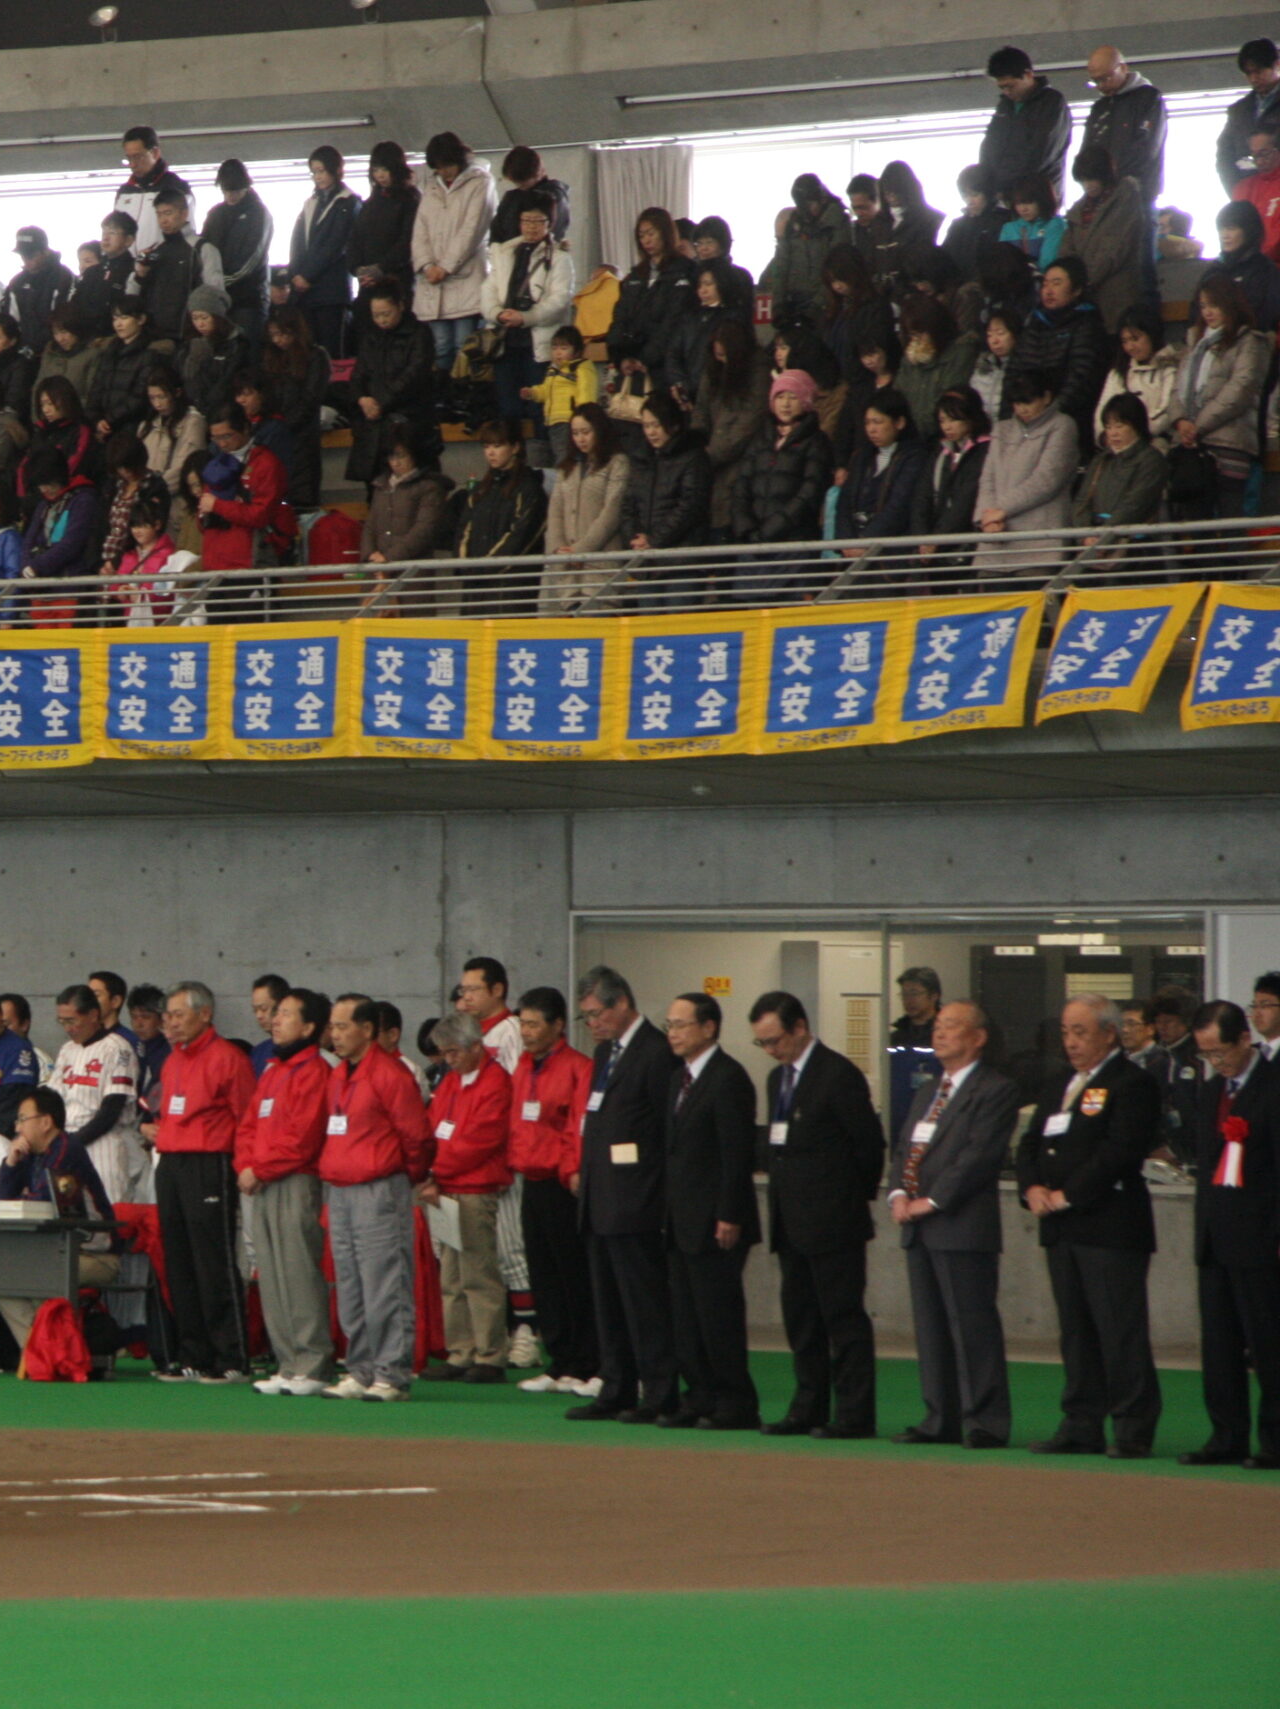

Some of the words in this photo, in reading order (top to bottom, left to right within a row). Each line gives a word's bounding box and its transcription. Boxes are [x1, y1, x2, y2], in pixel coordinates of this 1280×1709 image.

[783, 631, 871, 675] 交通
[923, 616, 1016, 664] 交通
[119, 651, 196, 689] 交通
[245, 646, 324, 686] 交通
[376, 646, 454, 687] 交通
[508, 647, 590, 687] 交通
[643, 641, 728, 684] 交通
[1047, 646, 1133, 685] 安全
[118, 695, 197, 733] 安全
[244, 691, 324, 731] 安全
[373, 691, 455, 731] 安全
[506, 693, 590, 733] 安全
[642, 688, 728, 731] 安全
[780, 678, 867, 723] 安全
